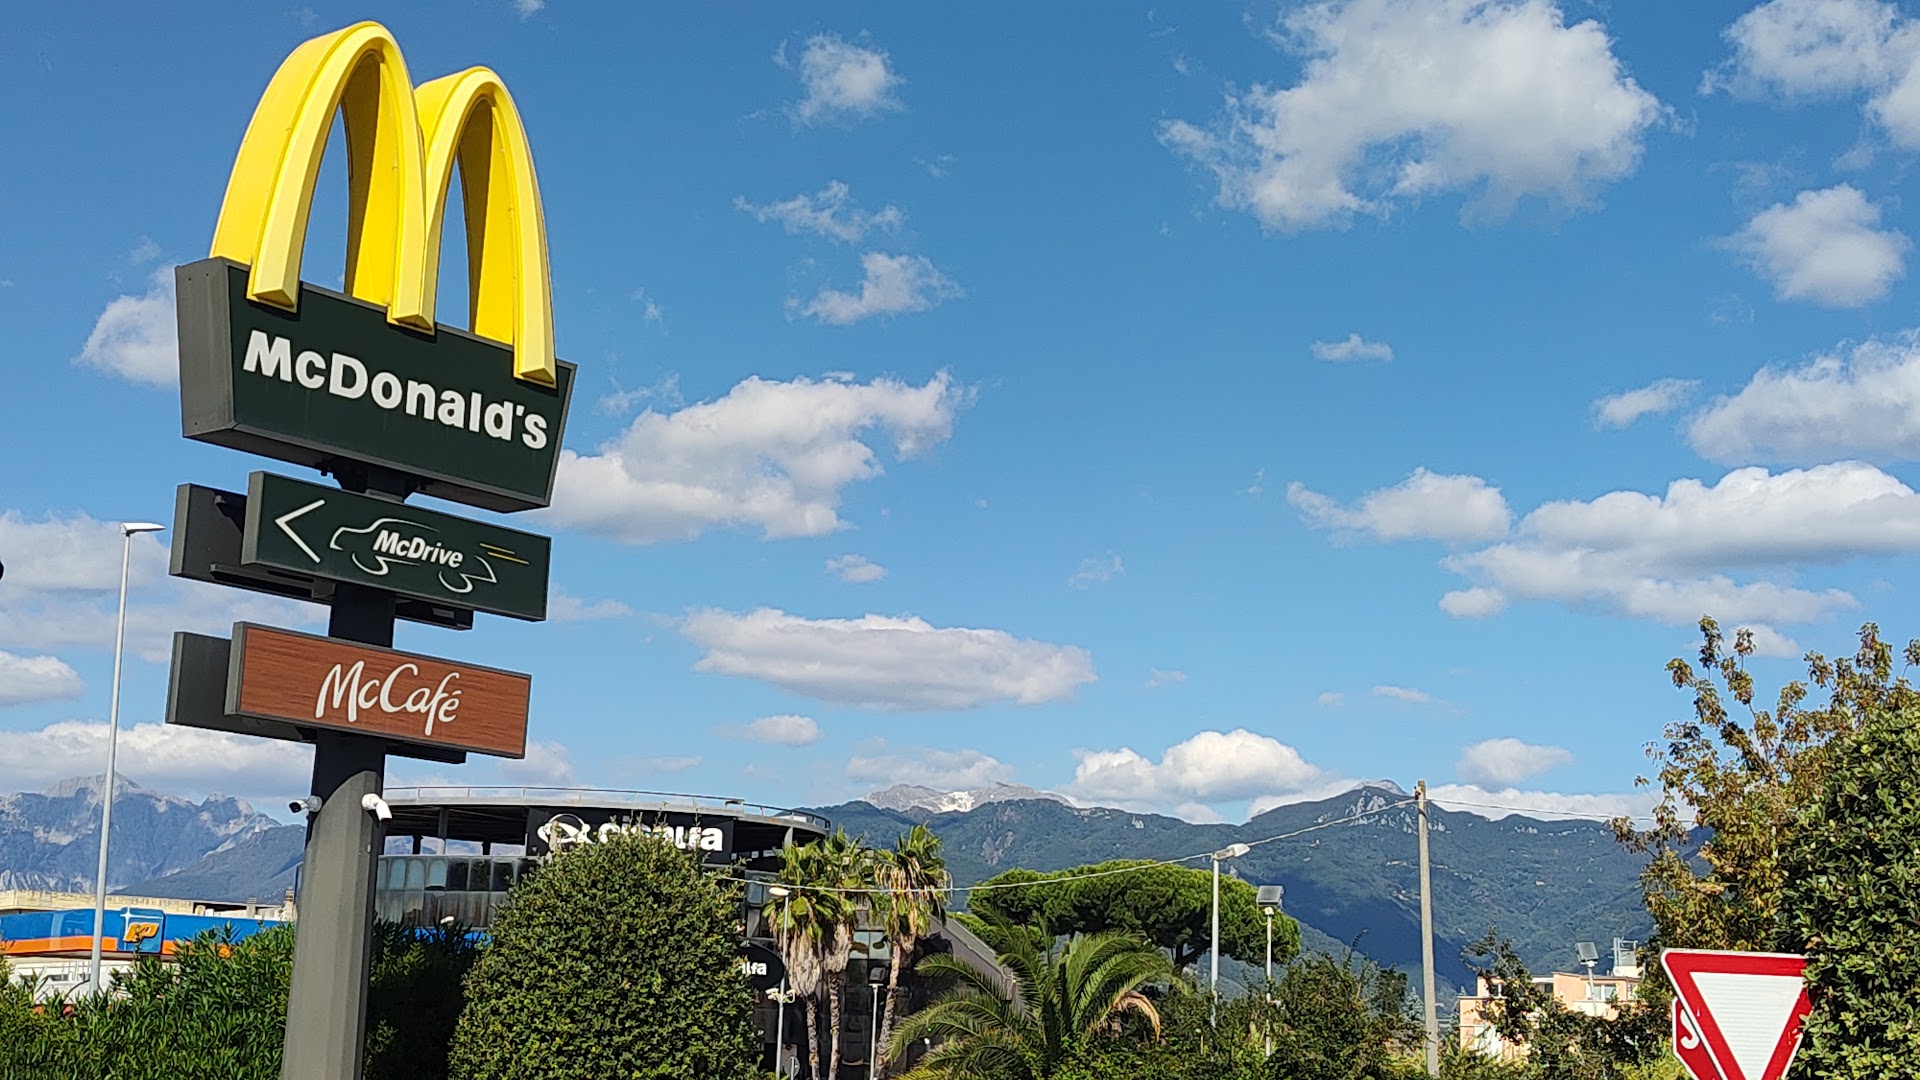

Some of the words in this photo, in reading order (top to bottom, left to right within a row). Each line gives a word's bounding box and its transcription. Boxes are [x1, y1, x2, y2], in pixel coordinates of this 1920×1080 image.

[242, 329, 548, 450] McDonald's
[373, 529, 464, 568] McDrive
[315, 660, 462, 736] McCafé
